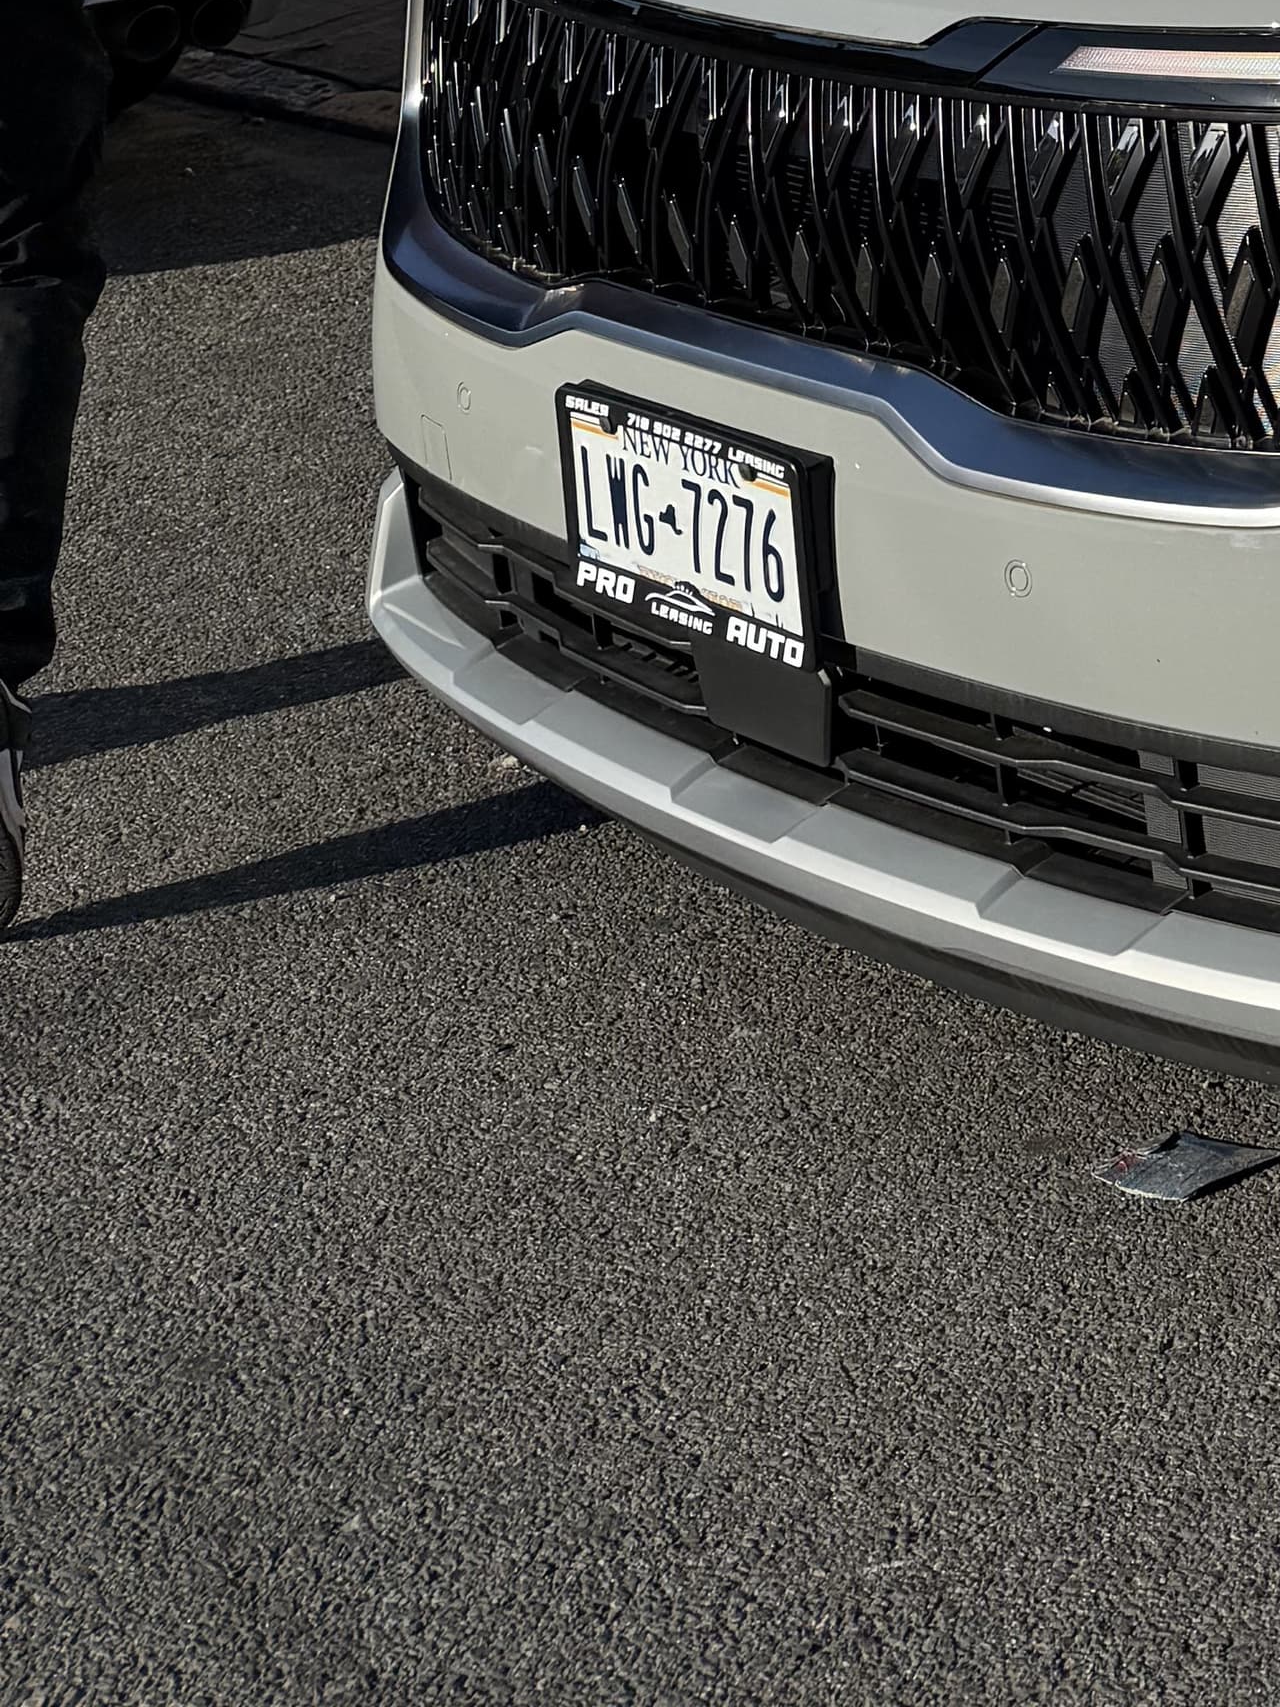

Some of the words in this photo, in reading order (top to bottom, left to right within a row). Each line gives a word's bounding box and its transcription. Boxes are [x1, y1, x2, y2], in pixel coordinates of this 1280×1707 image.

[565, 395, 609, 418] SALES
[618, 425, 672, 467] NEW
[680, 443, 740, 489] YORK
[627, 412, 649, 431] 718
[653, 419, 680, 441] 902
[684, 430, 722, 455] 2277
[727, 446, 785, 479] LEASING
[681, 477, 785, 603] 7276
[577, 560, 636, 605] PRO
[651, 601, 713, 636] LEASING
[726, 615, 805, 668] AUTO
